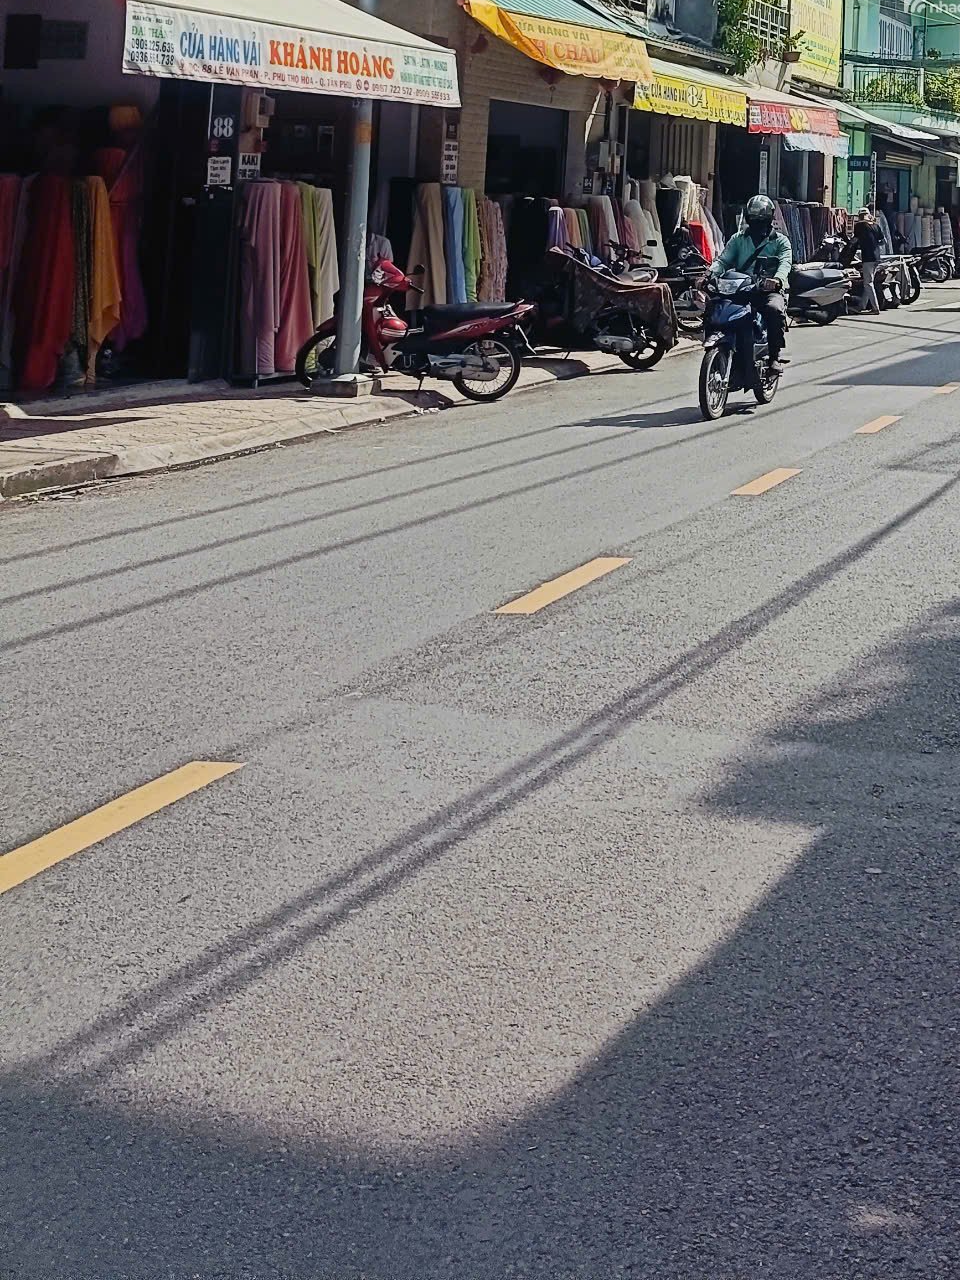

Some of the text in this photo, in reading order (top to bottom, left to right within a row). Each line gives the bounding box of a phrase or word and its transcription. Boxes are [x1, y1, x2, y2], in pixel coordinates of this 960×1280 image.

[180, 22, 395, 80] CỬA HÀNG VẢI KHÁNH HOÀNG
[202, 64, 212, 74] 88
[390, 84, 401, 94] 722
[402, 86, 413, 96] 572
[687, 85, 709, 109] 84
[213, 117, 233, 138] 88
